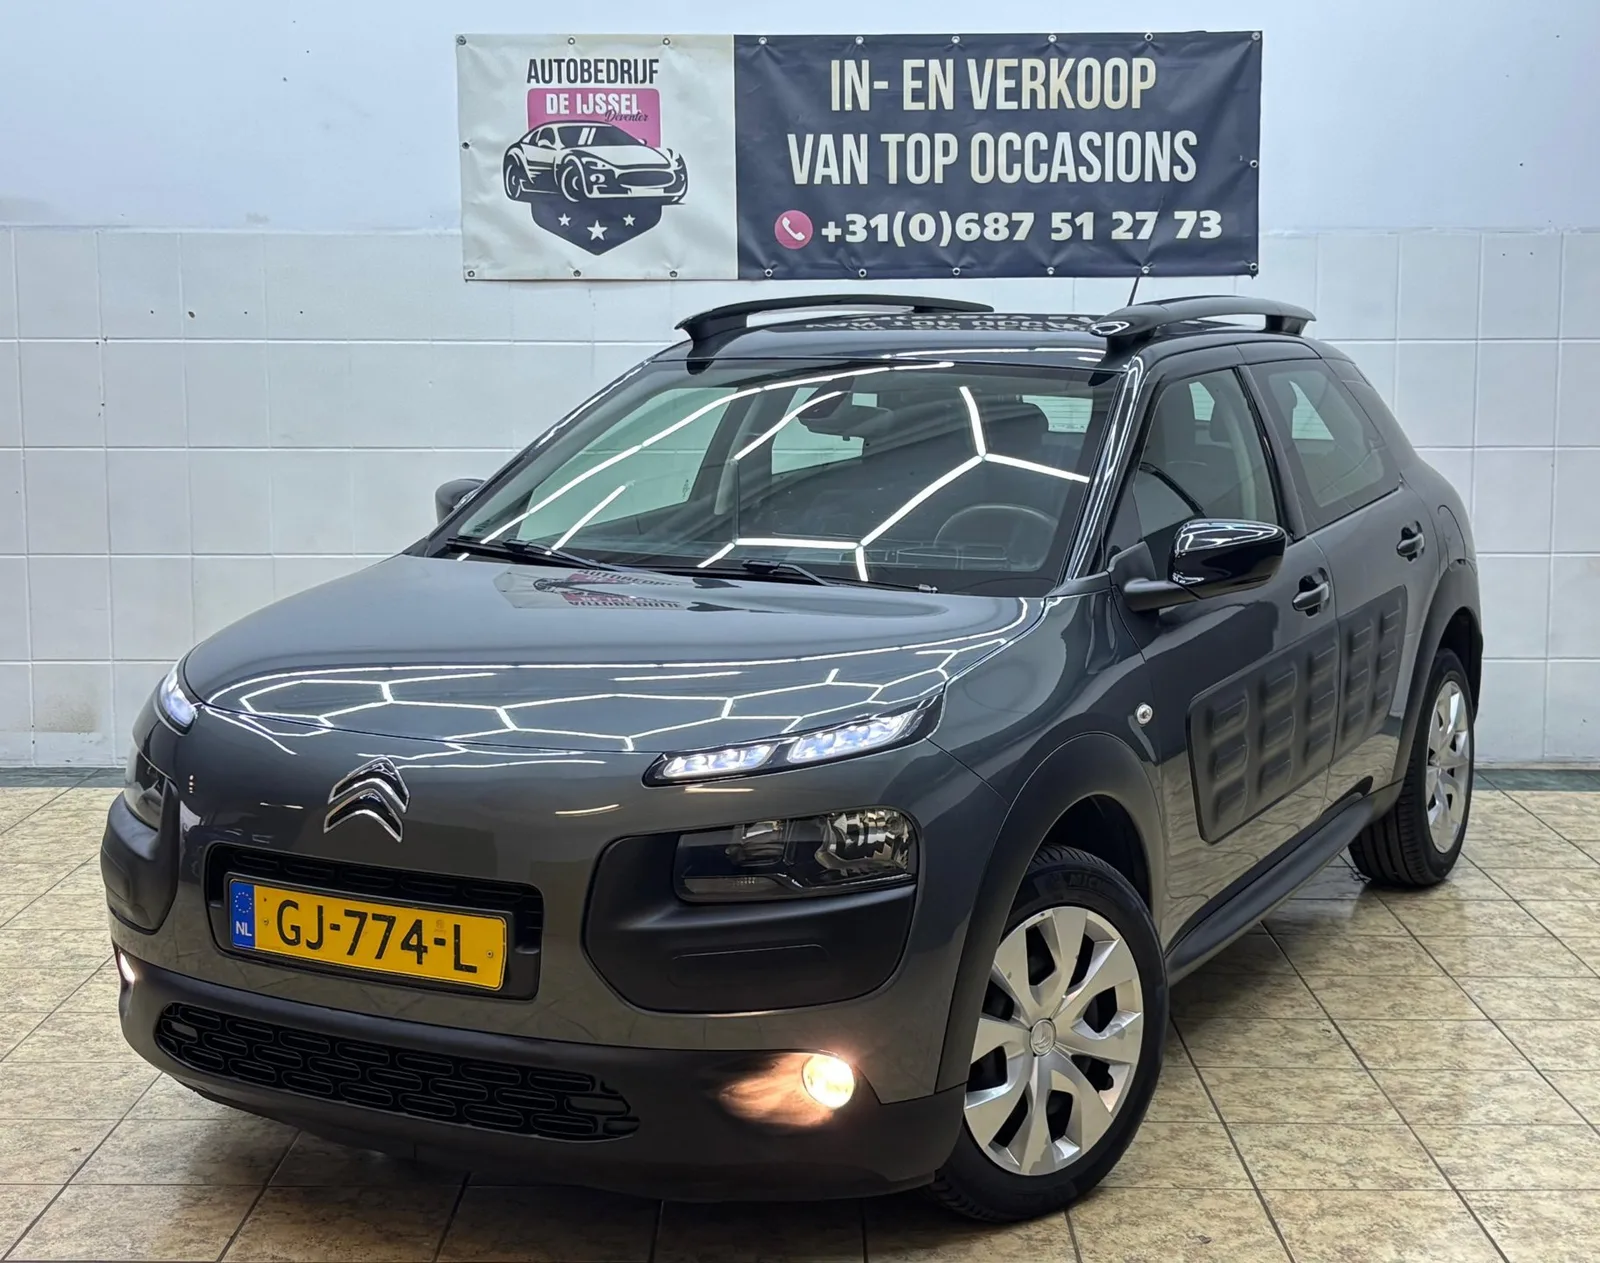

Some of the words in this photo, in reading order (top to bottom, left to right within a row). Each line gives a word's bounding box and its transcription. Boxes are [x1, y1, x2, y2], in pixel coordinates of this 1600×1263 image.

[527, 58, 660, 84] AUTOBEDRIJF
[830, 58, 889, 111] IN-
[903, 58, 954, 111] EN
[967, 57, 1156, 110] VERKOOP
[546, 93, 569, 115] DE
[576, 93, 642, 115] IJSSEL
[604, 109, 649, 122] Deventer
[787, 133, 869, 185] VAN
[880, 132, 958, 184] TOP
[969, 130, 1198, 183] OCCASIONS
[821, 211, 1035, 247] +31(0)687
[1050, 211, 1095, 241] 51
[1111, 210, 1158, 240] 27
[1173, 209, 1223, 239] 73
[235, 920, 253, 937] NL
[276, 899, 478, 974] GJ-774-L
